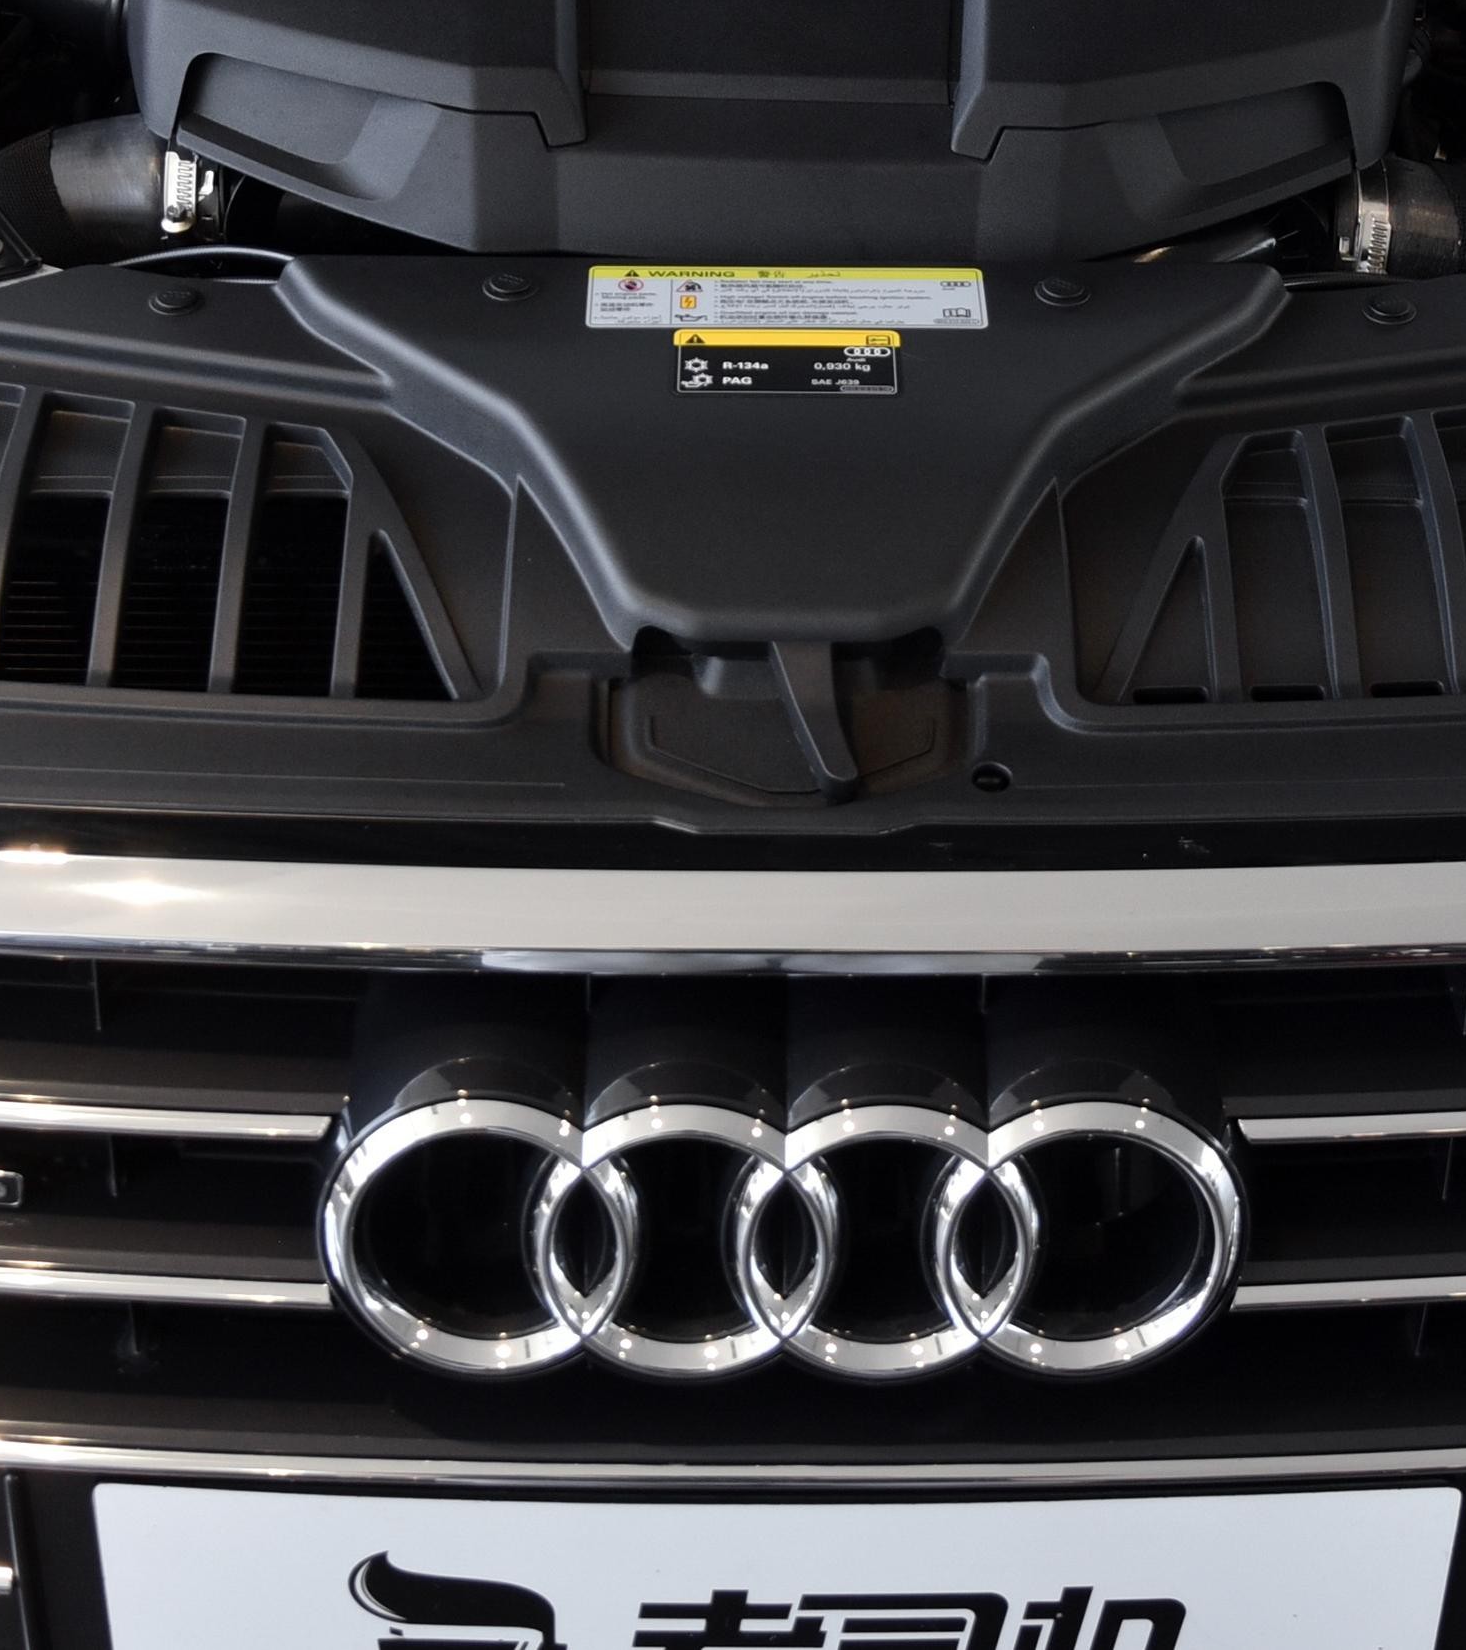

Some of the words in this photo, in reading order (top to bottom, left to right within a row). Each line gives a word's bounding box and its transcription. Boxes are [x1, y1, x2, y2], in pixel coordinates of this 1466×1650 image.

[648, 270, 735, 278] WARNING
[722, 361, 769, 370] R-134a
[854, 362, 871, 372] kg
[722, 376, 753, 385] PAG
